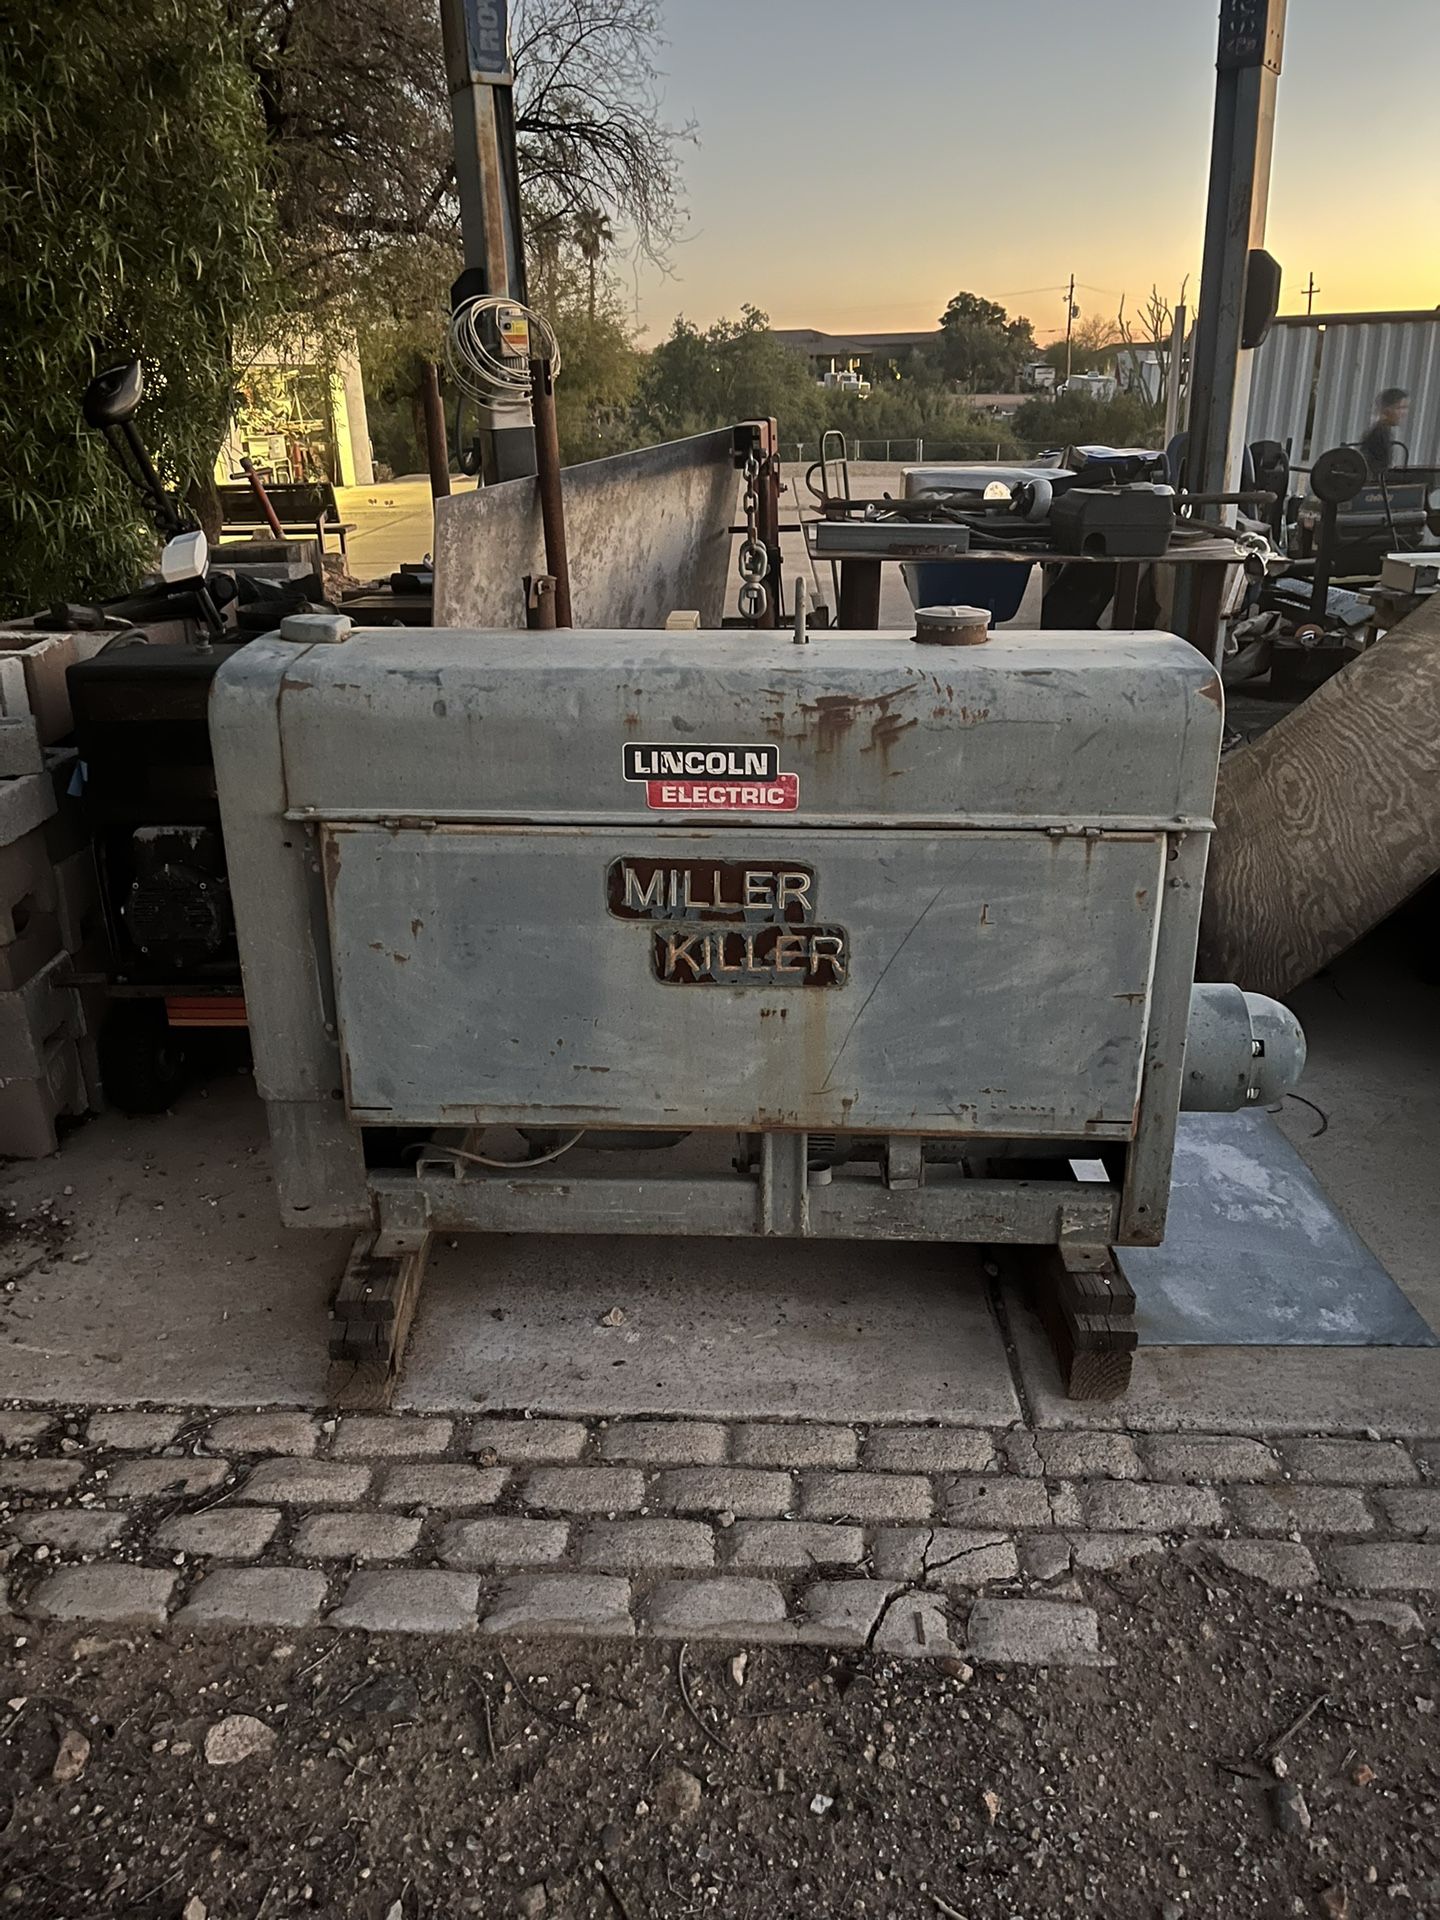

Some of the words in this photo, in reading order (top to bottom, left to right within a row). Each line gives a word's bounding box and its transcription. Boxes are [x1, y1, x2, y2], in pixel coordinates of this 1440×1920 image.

[634, 751, 768, 776] LINCOLN
[661, 786, 785, 805] ELECTRIC
[623, 868, 812, 910] MILLER
[664, 934, 846, 977] KILLER
